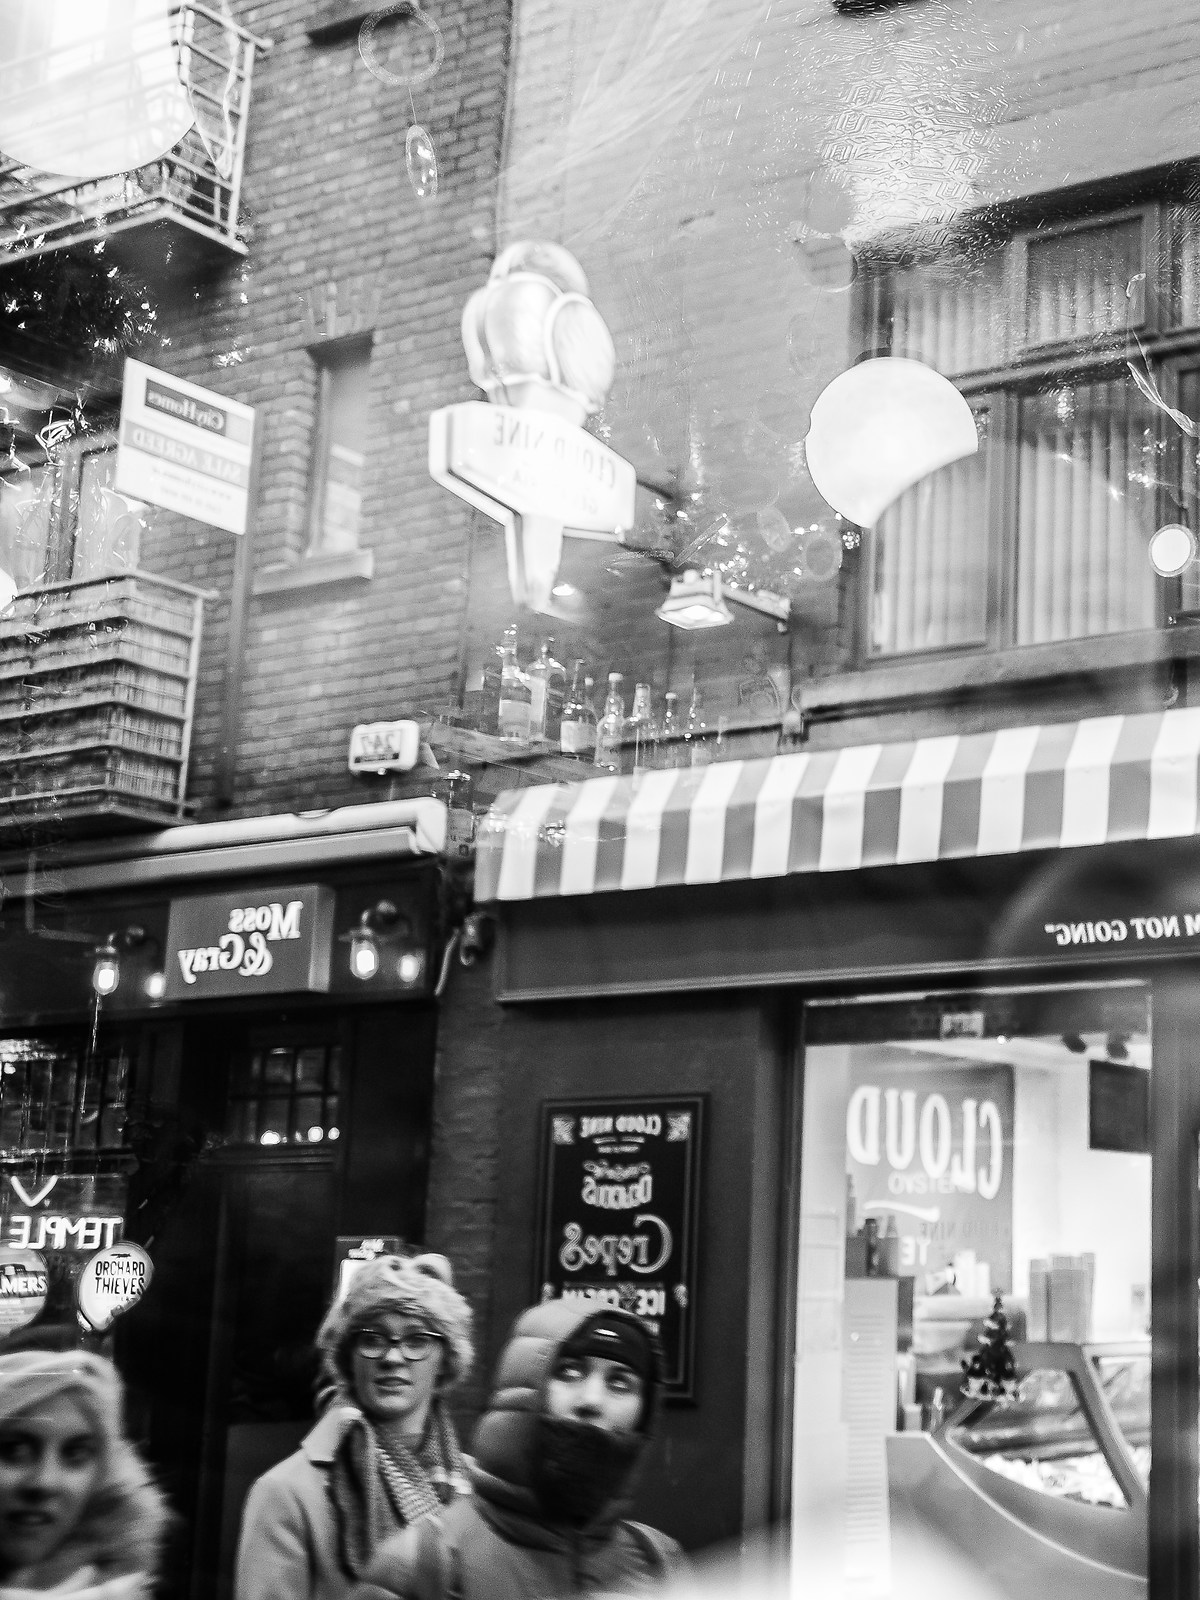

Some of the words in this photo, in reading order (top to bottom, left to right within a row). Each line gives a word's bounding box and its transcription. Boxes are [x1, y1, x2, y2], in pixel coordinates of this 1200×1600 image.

[95, 1260, 146, 1277] ORCHARD
[0, 1275, 48, 1295] MERS
[94, 1277, 147, 1296] THIEVES
